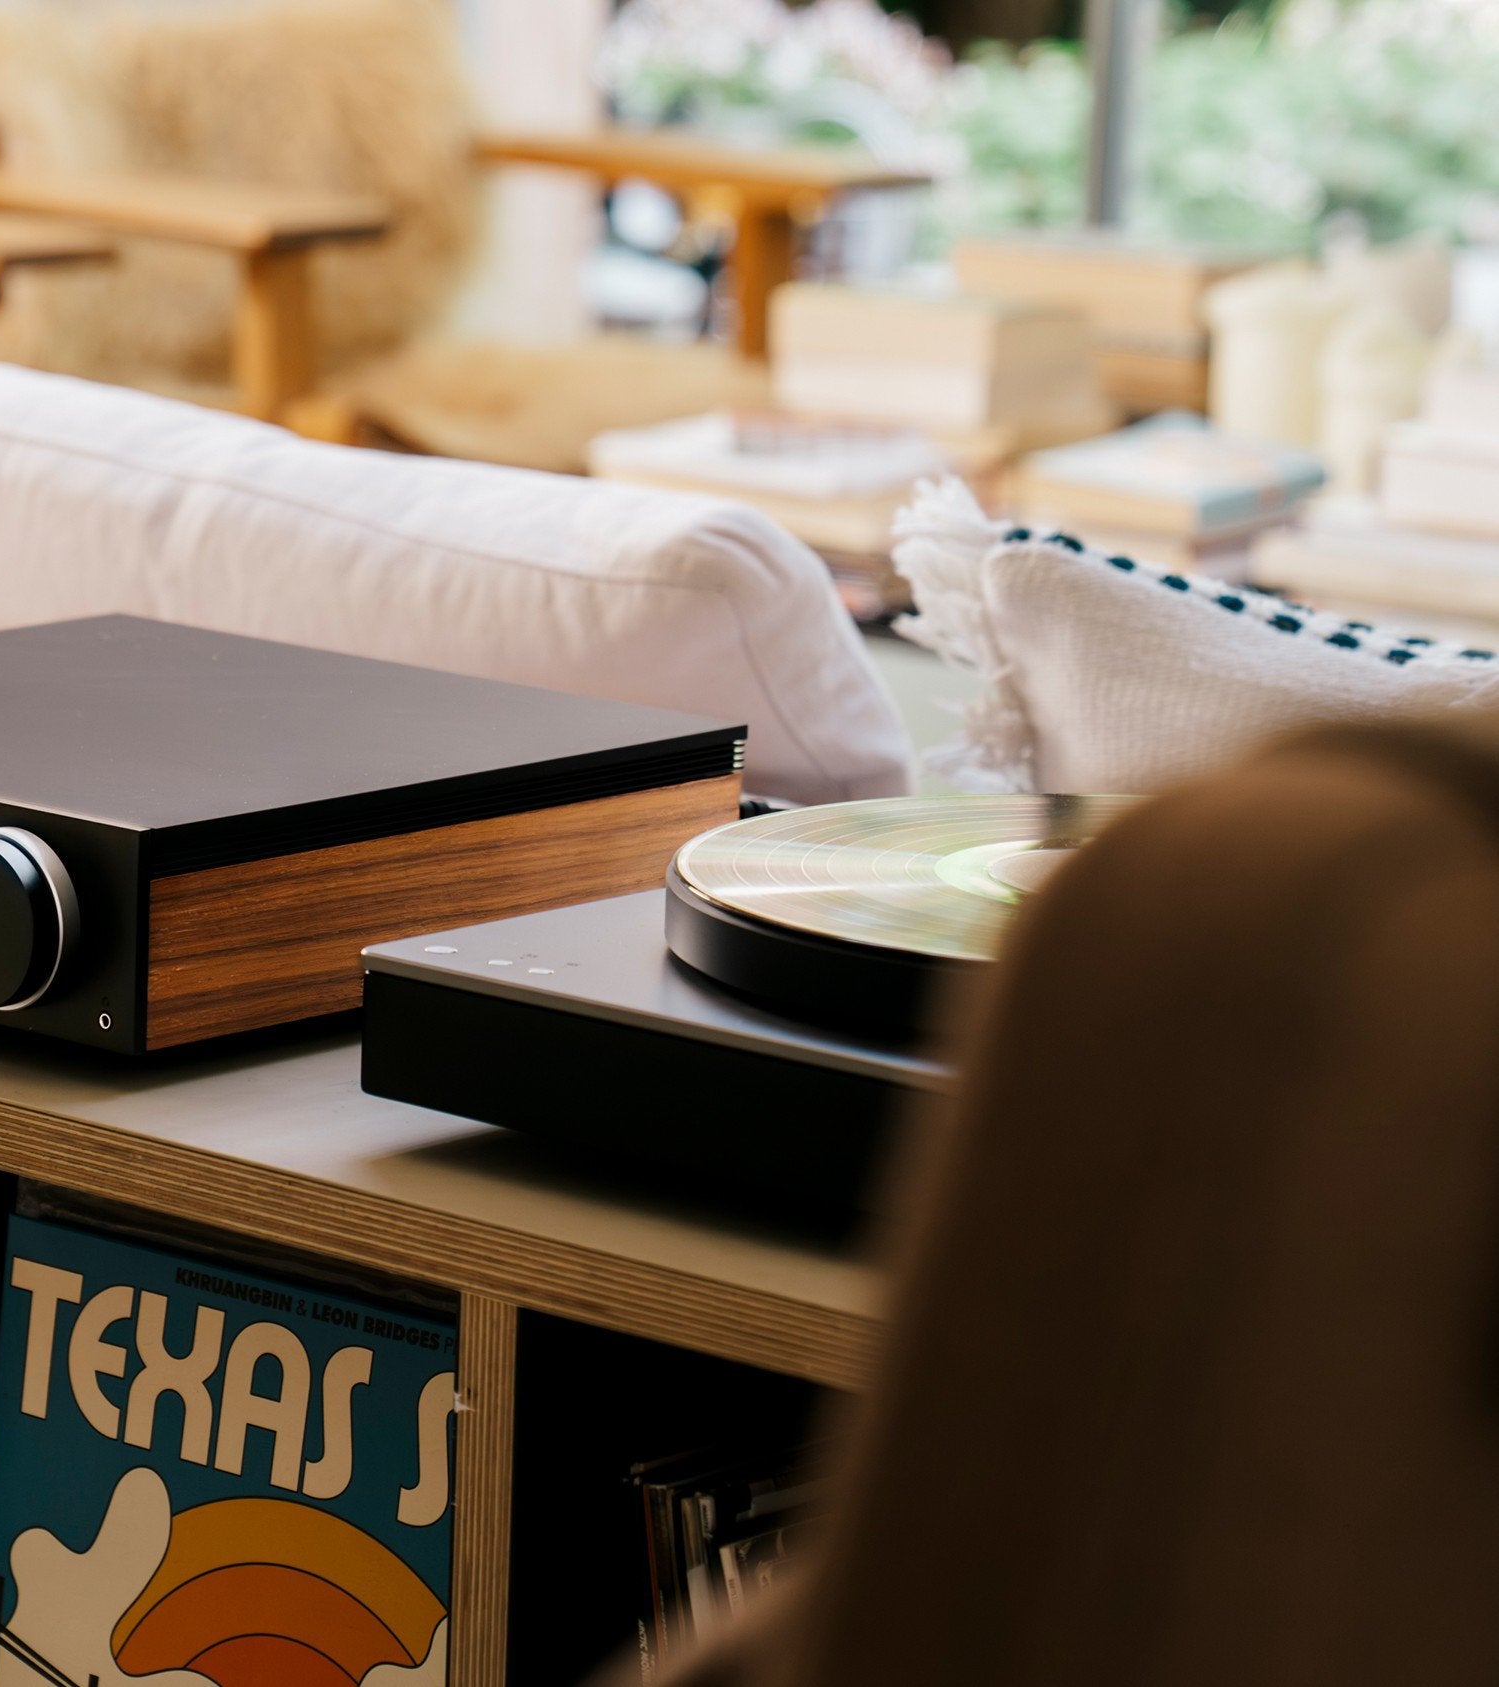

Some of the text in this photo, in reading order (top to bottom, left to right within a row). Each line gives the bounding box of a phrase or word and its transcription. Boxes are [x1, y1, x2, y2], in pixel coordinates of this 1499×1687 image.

[10, 1255, 375, 1501] TEXAS
[175, 1267, 292, 1313] KHRUANGBIN
[296, 1299, 307, 1316] &
[311, 1302, 360, 1330] LEON
[363, 1315, 440, 1351] BRIDGES
